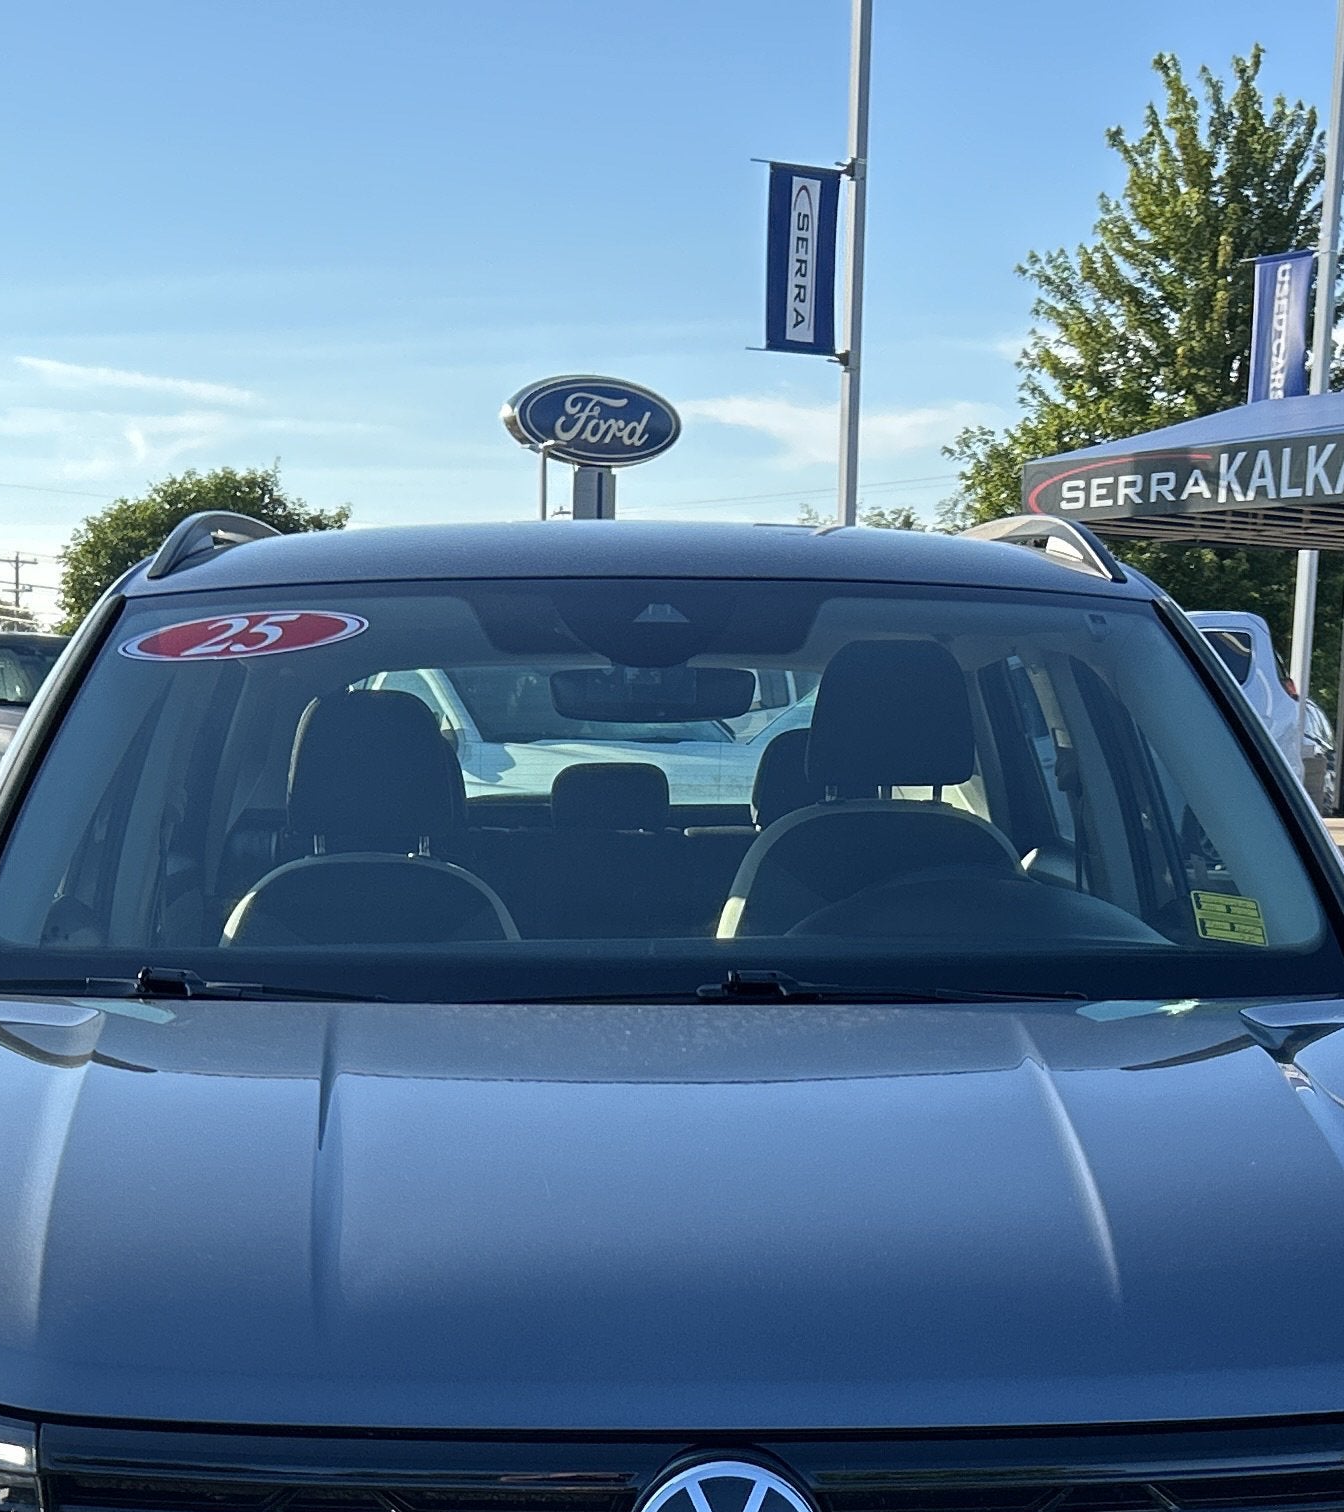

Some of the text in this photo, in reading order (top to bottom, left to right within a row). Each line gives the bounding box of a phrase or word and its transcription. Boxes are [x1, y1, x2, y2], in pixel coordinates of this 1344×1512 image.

[792, 212, 810, 329] SERRA
[555, 392, 652, 447] Ford
[1059, 468, 1212, 510] SERRA
[180, 614, 301, 656] 25
